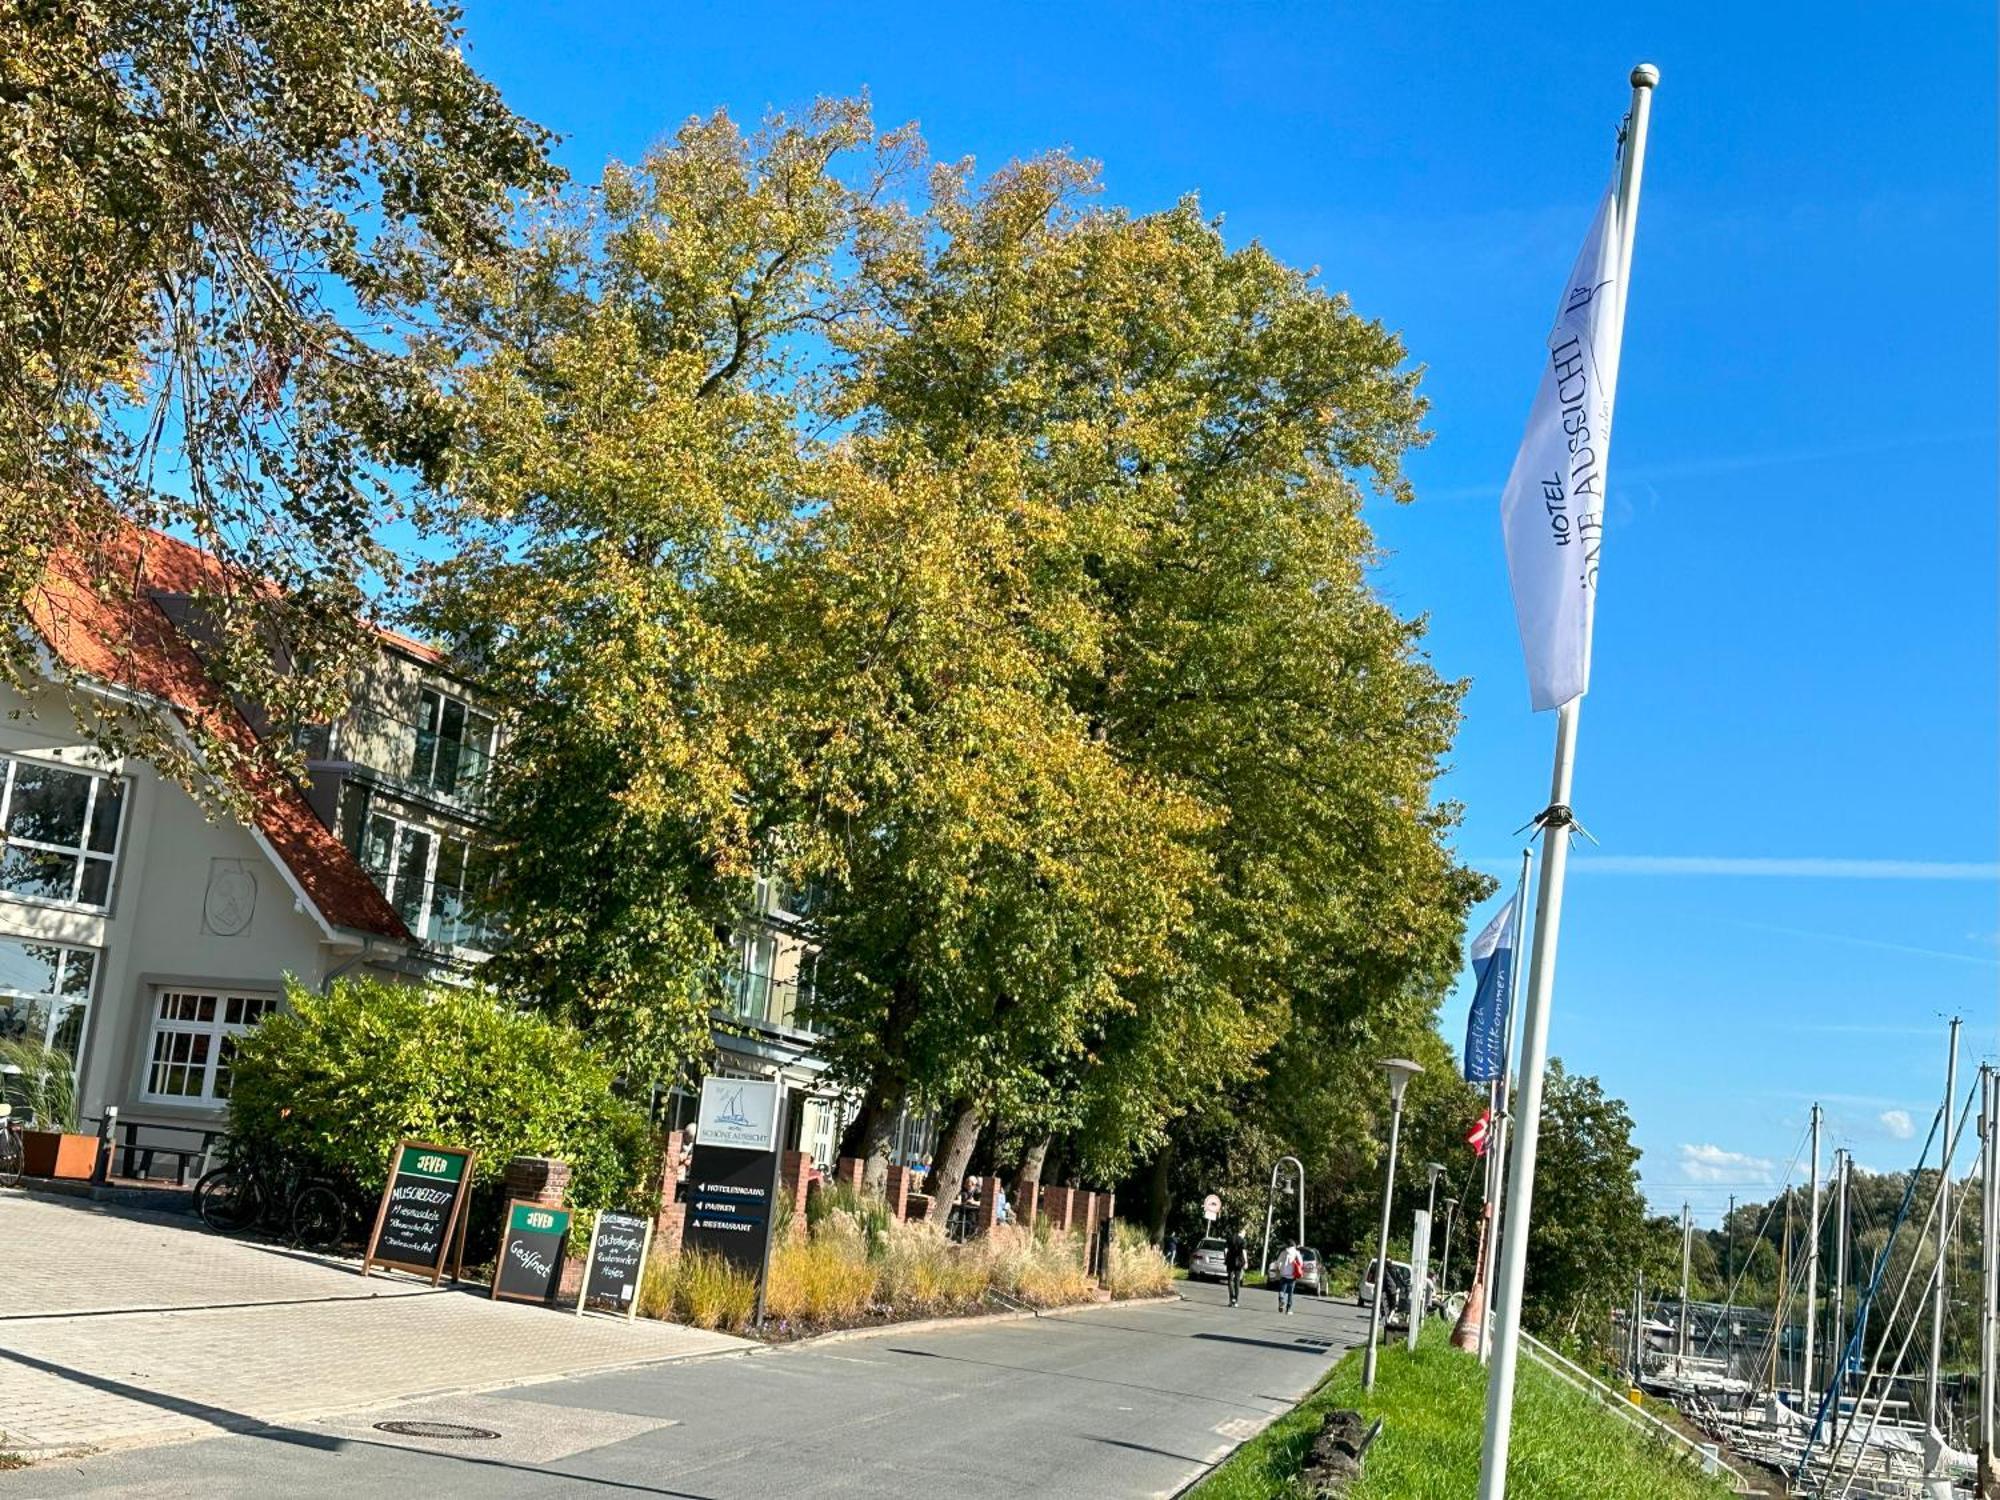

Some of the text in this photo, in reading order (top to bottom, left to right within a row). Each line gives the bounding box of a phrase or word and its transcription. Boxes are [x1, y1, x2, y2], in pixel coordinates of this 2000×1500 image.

[1541, 471, 1571, 546] HOTEL
[1487, 969, 1506, 1078] Willkommen
[1471, 1006, 1486, 1078] Herzlich
[417, 1155, 448, 1173] JEVER
[526, 1212, 554, 1229] JEVER
[704, 1202, 736, 1213] PARKEN
[702, 1220, 752, 1232] RESTAURANT
[510, 1240, 553, 1278] Geöffnet
